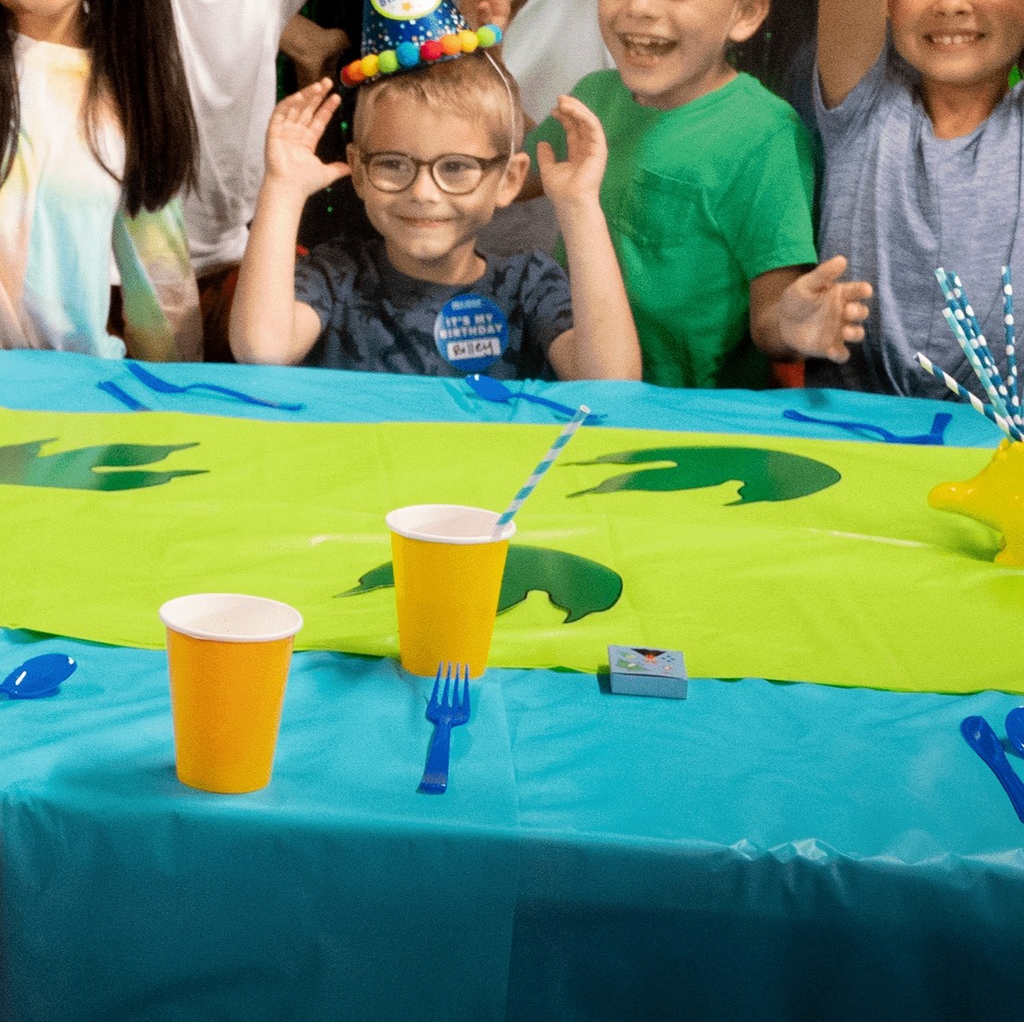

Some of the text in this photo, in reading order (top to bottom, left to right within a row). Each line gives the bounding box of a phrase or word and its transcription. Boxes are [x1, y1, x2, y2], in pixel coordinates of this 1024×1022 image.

[446, 313, 493, 327] IT'S MY
[439, 324, 503, 339] BIRTHDAY
